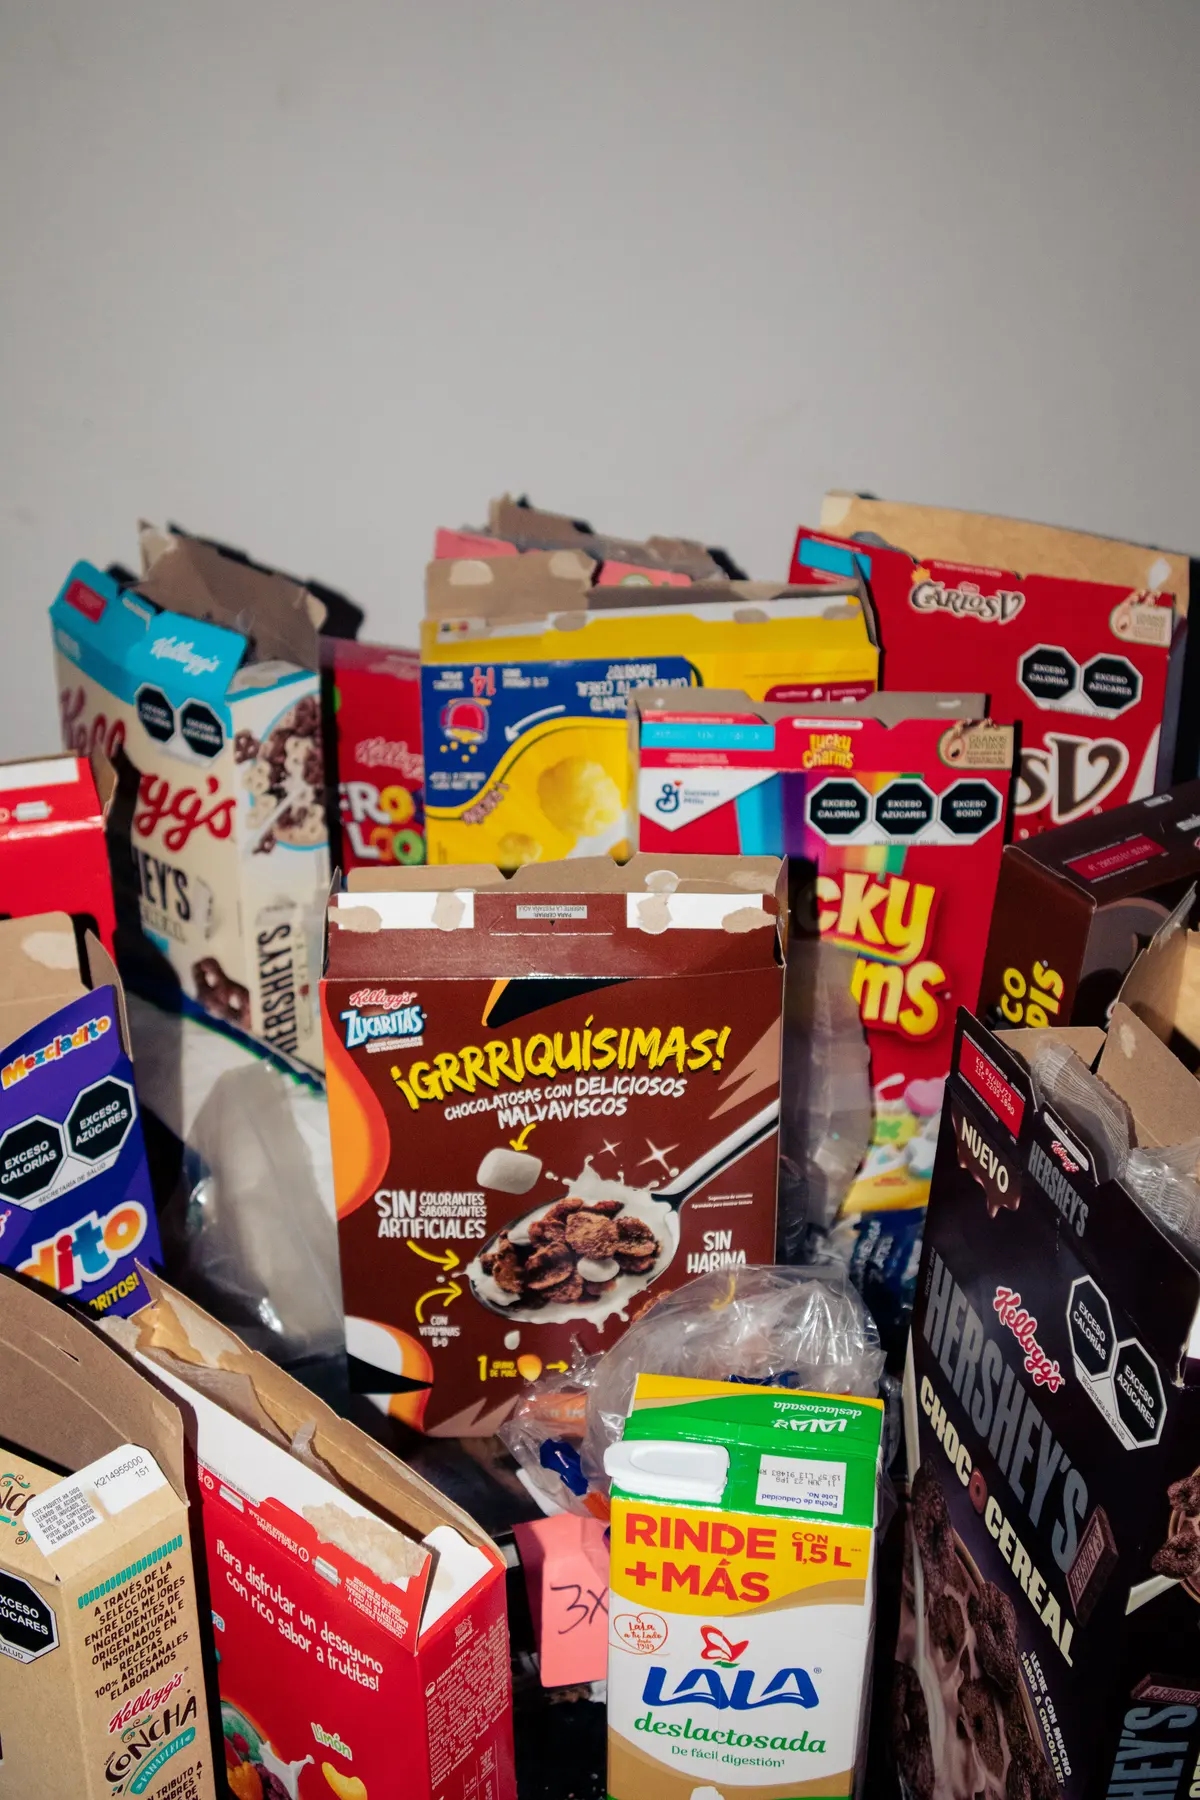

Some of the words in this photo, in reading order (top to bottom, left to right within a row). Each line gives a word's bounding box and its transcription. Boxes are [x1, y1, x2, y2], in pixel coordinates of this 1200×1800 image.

[349, 988, 412, 1010] Kellogg's
[340, 1005, 424, 1049] ZUCARITAS
[1, 1015, 112, 1091] Mezcladito
[390, 1014, 732, 1111] ¡GRRRIQUÍSIMAS!
[79, 1100, 120, 1130] EXCESO
[444, 1089, 543, 1121] CHOCOLATOSAS
[545, 1083, 573, 1100] CON
[575, 1076, 687, 1098] DELICIOSOS
[498, 1097, 628, 1130] MALVAVISCOS
[75, 1108, 128, 1147] AZÚCARES
[1, 1150, 57, 1185] CALORÍAS
[4, 1139, 50, 1170] EXCESO
[961, 1116, 1010, 1194] NUEVO
[374, 1189, 417, 1218] SIN
[420, 1192, 485, 1206] COLORANTES
[1028, 1140, 1090, 1238] HERSHEY'S
[378, 1218, 487, 1239] ARTIFICIALES
[419, 1205, 487, 1218] SABORIZANTES
[703, 1229, 732, 1251] SIN
[419, 1326, 460, 1337] VITAMINAS
[993, 1285, 1062, 1394] Kellogg's
[1073, 1310, 1107, 1361] CALORÍAS
[1078, 1301, 1106, 1343] EXCESO
[477, 1355, 488, 1381] 1
[1124, 1364, 1155, 1409] EXCESO
[773, 1401, 862, 1420] deslactosada
[922, 1254, 1089, 1574] HERSHEY'S
[1116, 1373, 1156, 1430] AZÚCARES
[94, 1455, 144, 1489] K214955000
[135, 1465, 150, 1479] 151
[31, 1506, 43, 1518] ESTE
[43, 1497, 62, 1514] PAQUETE
[62, 1492, 70, 1500] HA
[69, 1486, 81, 1497] SIDO
[35, 1509, 55, 1524] LLENADO
[55, 1504, 63, 1512] DE
[63, 1492, 84, 1508] ACUERDO
[762, 1492, 802, 1505] Caducidad
[803, 1497, 813, 1505] de
[807, 1491, 820, 1499] No.
[814, 1499, 838, 1509] Fecha
[821, 1493, 839, 1502] Lote
[39, 1521, 46, 1529] AL
[46, 1513, 58, 1525] PESO
[42, 1524, 56, 1535] NIVEL
[57, 1518, 66, 1529] DEL
[46, 1529, 61, 1540] PUEDE
[63, 1519, 76, 1530] BAJAR
[77, 1508, 95, 1522] DEBIDO
[57, 1528, 74, 1541] MANEJO
[73, 1524, 80, 1532] DE
[79, 1520, 86, 1529] LA
[625, 1513, 777, 1560] RINDE
[791, 1531, 828, 1544] CON
[833, 1546, 852, 1568] L
[94, 1606, 101, 1617] A
[103, 1580, 142, 1611] TRAVÉS
[144, 1569, 158, 1585] DE
[160, 1561, 173, 1575] LA
[624, 1558, 770, 1603] +MÁS
[984, 1494, 1075, 1667] CEREAL
[84, 1619, 119, 1647] ENTRE
[121, 1607, 139, 1624] LOS
[141, 1575, 186, 1611] MEJORES
[99, 1583, 155, 1626] SELECCIÓN
[157, 1573, 170, 1589] DE
[216, 1538, 243, 1575] ¡Para
[245, 1563, 296, 1617] disfrutar
[299, 1609, 317, 1634] un
[320, 1621, 384, 1675] desayuno
[347, 1594, 352, 1603] Y
[352, 1598, 376, 1620] FRESCO
[364, 1599, 373, 1609] TU
[372, 1604, 407, 1635] CRUJIENTE
[549, 1581, 609, 1635] 3X
[0, 1606, 49, 1636] ÚCARES
[91, 1635, 130, 1666] ORIGEN
[132, 1608, 176, 1641] NATURAL
[178, 1599, 185, 1610] E
[92, 1601, 165, 1654] INGREDIENTES
[168, 1590, 181, 1606] DE
[226, 1571, 249, 1602] con
[251, 1593, 275, 1625] rico
[278, 1618, 312, 1654] sabor
[316, 1645, 324, 1664] a
[327, 1647, 380, 1692] frutitas!
[101, 1626, 161, 1672] INSPIRADOS
[164, 1615, 177, 1631] EN
[119, 1637, 164, 1672] RECETAS
[94, 1679, 119, 1699] 100%
[121, 1631, 189, 1683] ARTESANALES
[110, 1650, 177, 1701] ELABORAMOS
[1020, 1651, 1038, 1692] SABOR
[1034, 1695, 1042, 1706] A
[108, 1673, 184, 1735] Kellogg's
[642, 1665, 820, 1710] LALA
[104, 1695, 198, 1783] CONCHA
[310, 1722, 353, 1761] Limón
[633, 1711, 827, 1754] deslactosada
[1044, 1695, 1058, 1725] CON
[1053, 1726, 1072, 1777] MUCHO
[671, 1745, 689, 1757] De
[691, 1748, 718, 1762] fácil
[156, 1766, 194, 1799] TRIBUTO
[196, 1760, 203, 1770] A
[185, 1785, 197, 1800] DE
[196, 1771, 202, 1780] Y
